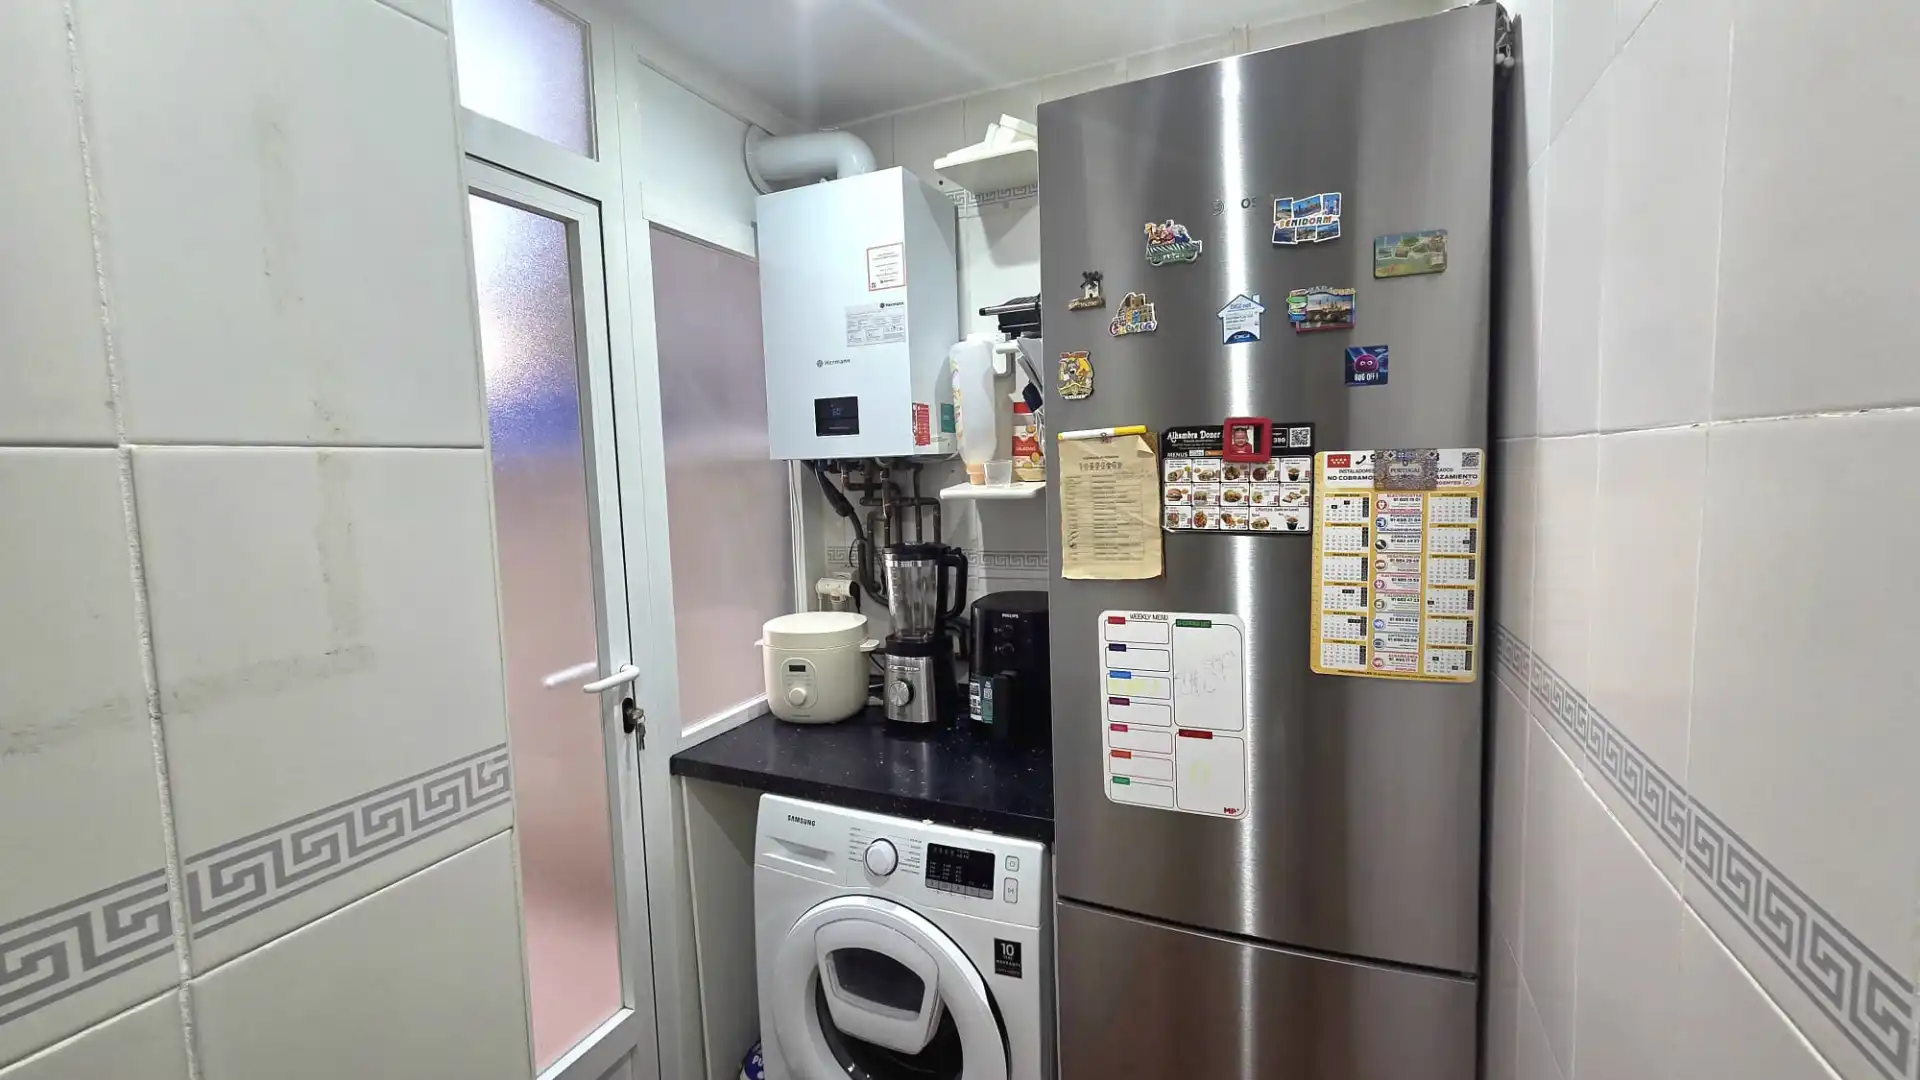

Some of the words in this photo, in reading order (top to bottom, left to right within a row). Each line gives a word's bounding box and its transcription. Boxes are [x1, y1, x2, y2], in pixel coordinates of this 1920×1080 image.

[1279, 215, 1332, 229] BENIDORM
[1354, 372, 1366, 382] BUG
[1167, 430, 1198, 443] Alhambra
[1130, 612, 1151, 620] WEEKLY
[787, 814, 816, 827] SAMSUNG
[1000, 942, 1015, 957] 10
